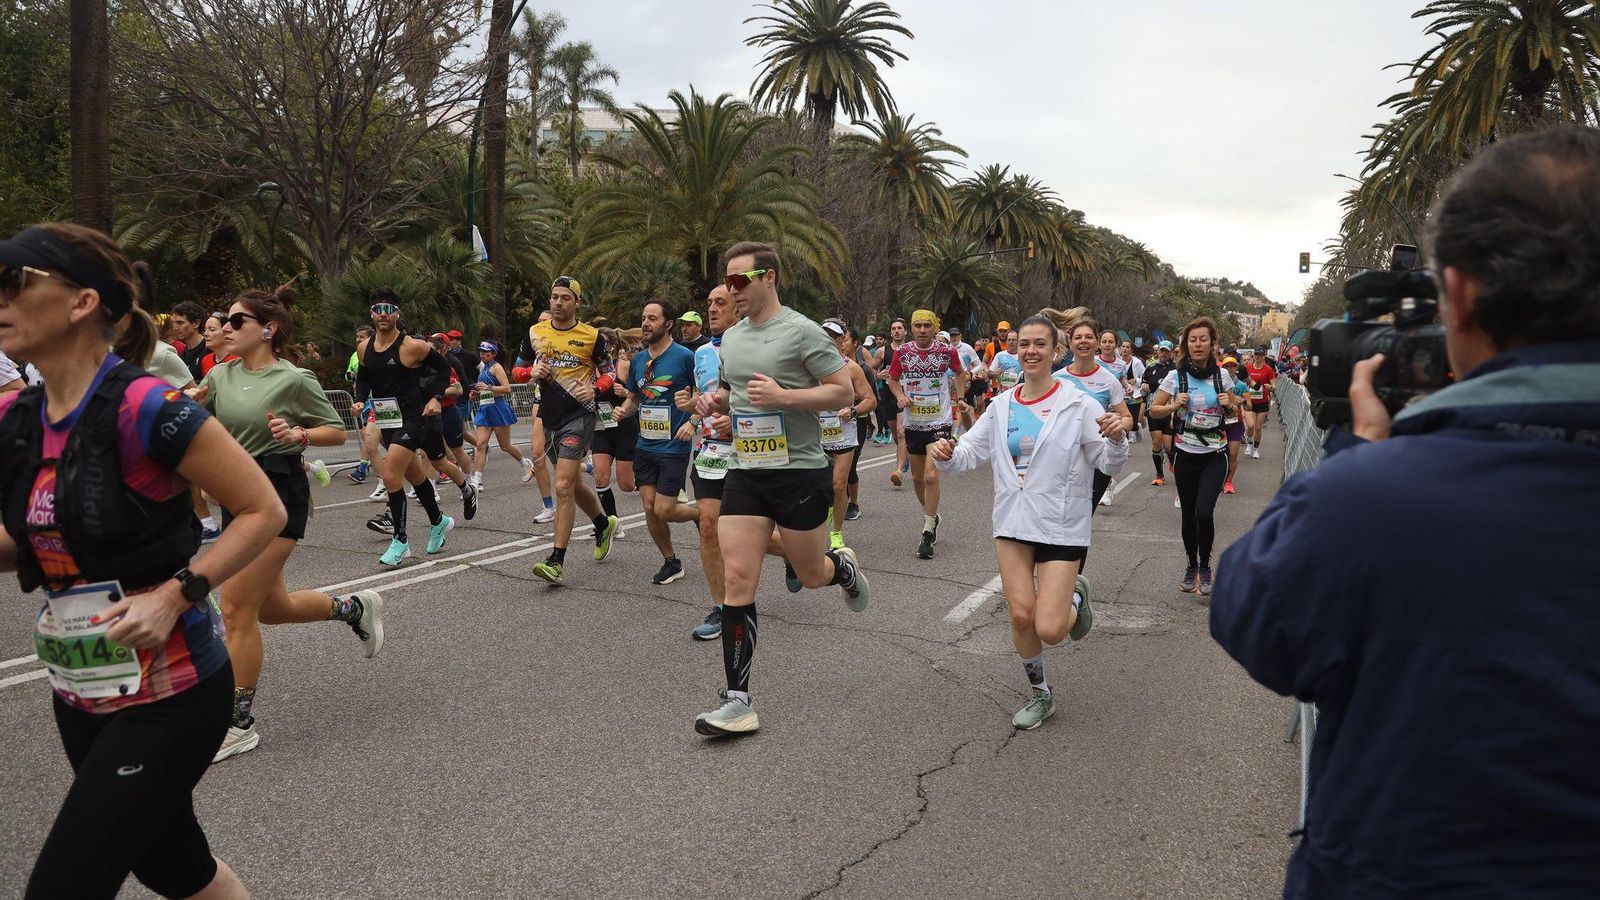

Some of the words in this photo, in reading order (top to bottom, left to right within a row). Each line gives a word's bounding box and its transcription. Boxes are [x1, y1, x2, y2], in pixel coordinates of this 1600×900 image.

[560, 354, 580, 362] TRAIL
[548, 359, 578, 368] SANTO
[917, 406, 936, 414] 1532
[643, 421, 665, 431] 1680
[742, 438, 778, 453] 3370
[702, 456, 728, 469] 4950
[44, 636, 113, 667] 5814
